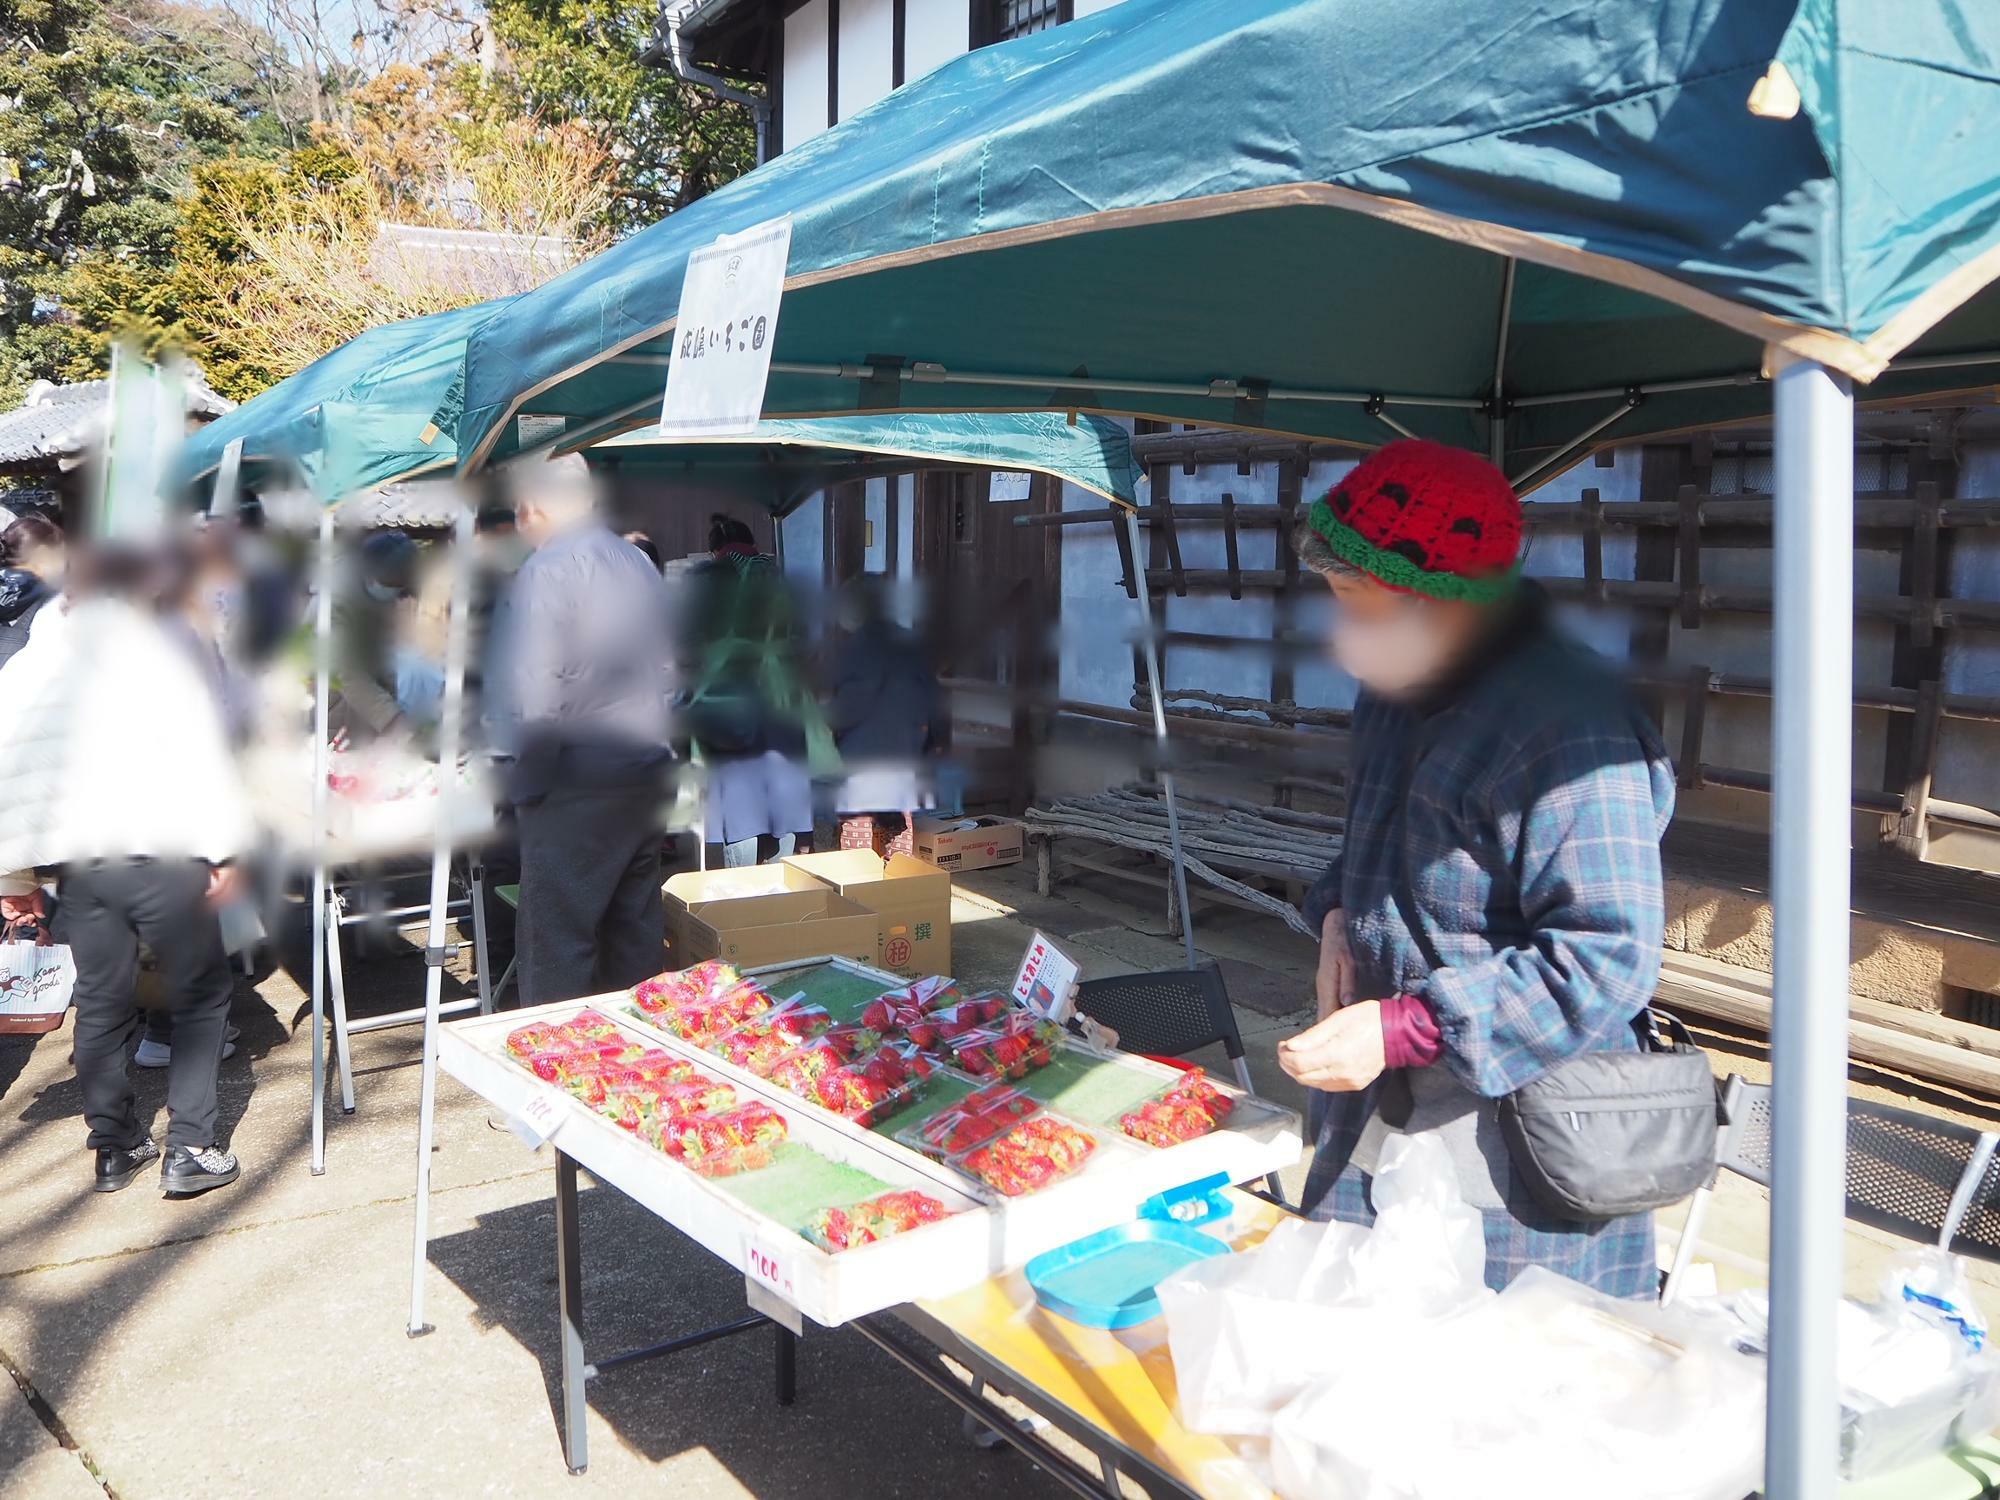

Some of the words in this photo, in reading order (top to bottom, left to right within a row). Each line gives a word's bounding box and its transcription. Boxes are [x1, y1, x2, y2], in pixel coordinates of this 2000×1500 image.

[914, 923, 932, 941] 撰
[887, 941, 909, 963] 柏
[1017, 944, 1045, 996] とちおとめ
[32, 973, 60, 1002] goods
